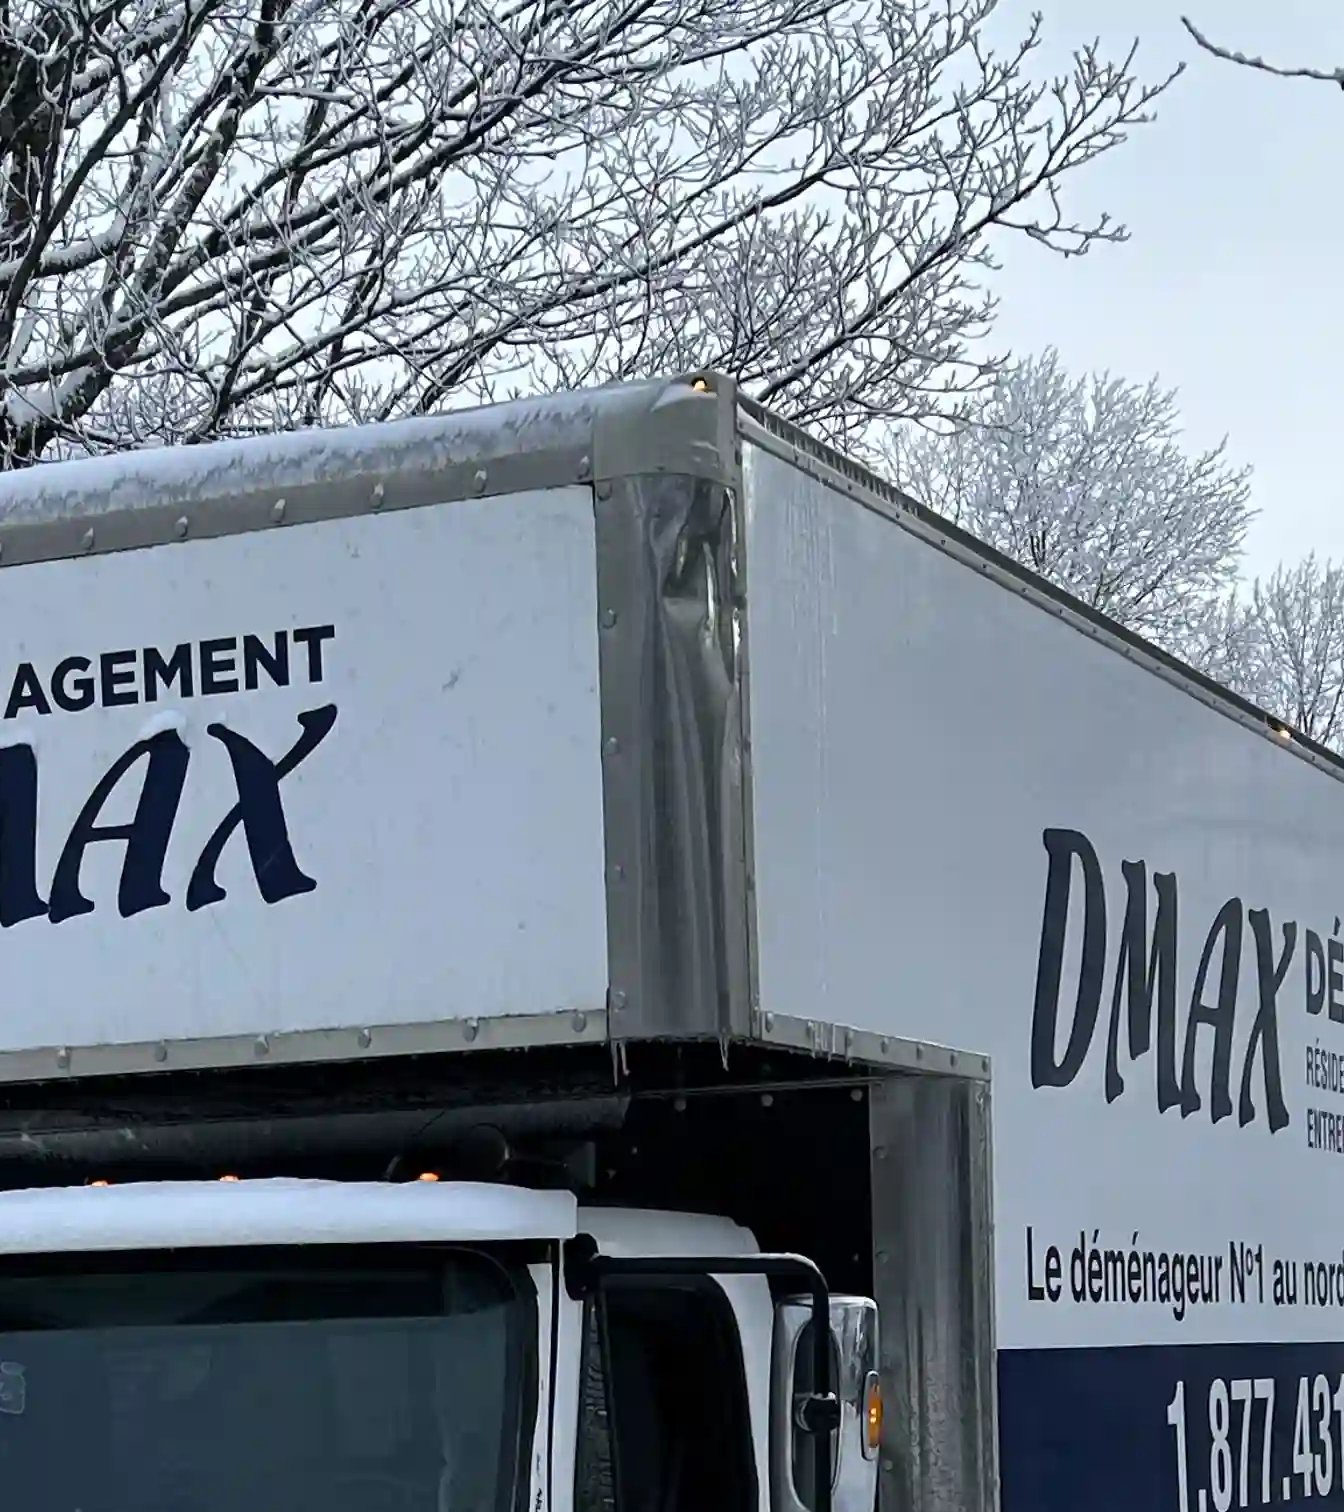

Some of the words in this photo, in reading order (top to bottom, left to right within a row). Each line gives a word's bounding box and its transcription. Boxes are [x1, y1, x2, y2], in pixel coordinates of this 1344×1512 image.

[1031, 828, 1297, 1134] DMAX
[1026, 1226, 1062, 1301] Le
[1070, 1229, 1223, 1322] déménageur
[1273, 1256, 1297, 1306] au
